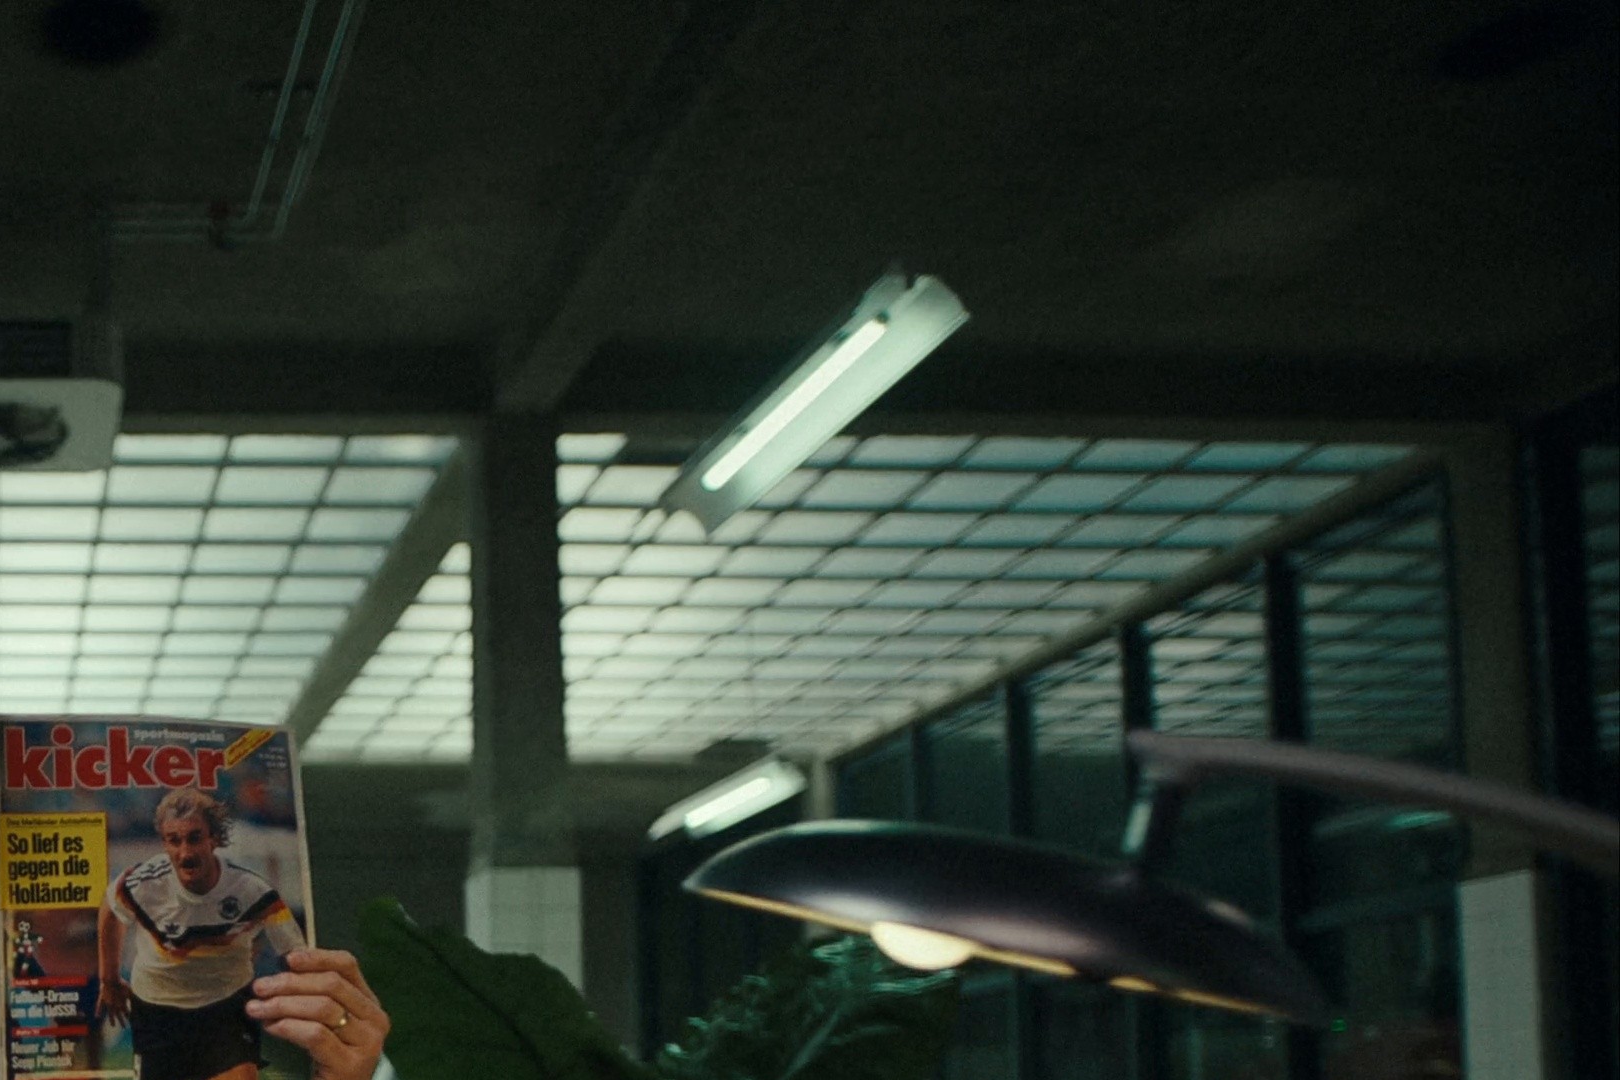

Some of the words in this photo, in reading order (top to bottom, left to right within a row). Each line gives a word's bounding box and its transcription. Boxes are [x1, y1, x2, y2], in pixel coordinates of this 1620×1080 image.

[3, 725, 227, 790] kicker
[7, 832, 29, 855] So
[31, 832, 59, 854] lief
[62, 836, 84, 853] es
[8, 859, 60, 881] gegen
[63, 855, 90, 876] die
[9, 881, 92, 904] Holländer
